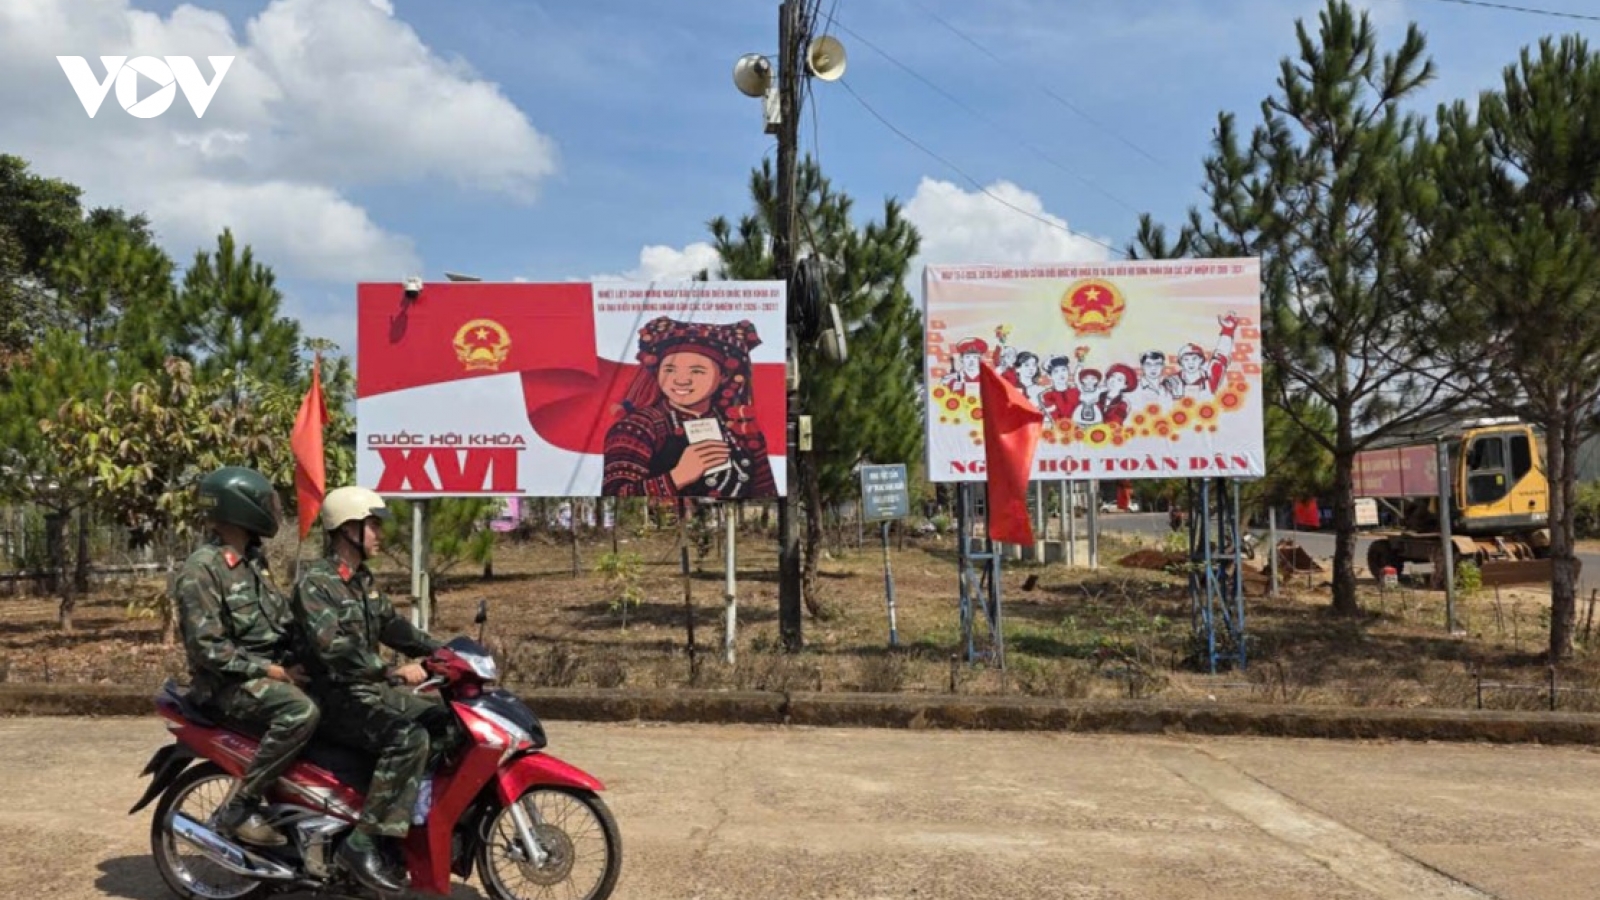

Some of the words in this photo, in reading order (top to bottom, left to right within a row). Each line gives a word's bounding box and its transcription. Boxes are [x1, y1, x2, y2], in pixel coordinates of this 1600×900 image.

[368, 430, 423, 445] QUỐC
[430, 431, 462, 447] HỘI
[468, 431, 526, 445] KHÓA
[375, 446, 518, 493] XVI
[949, 460, 987, 475] NG
[1037, 455, 1091, 475] HỘI
[1100, 453, 1180, 473] TOÀN
[1188, 451, 1251, 472] DÂN
